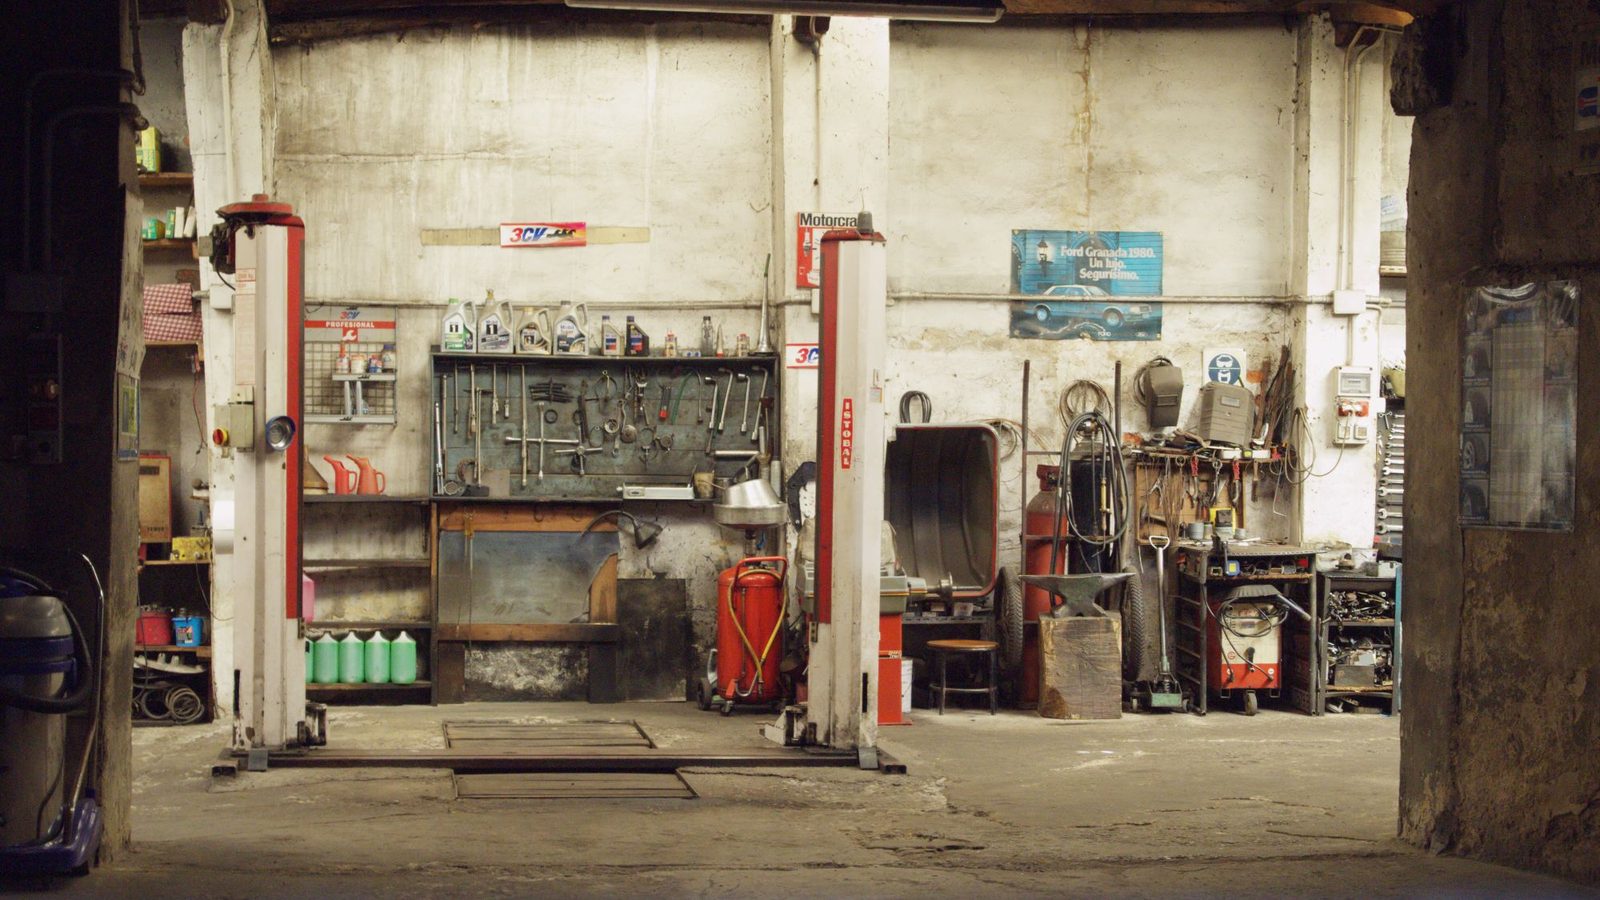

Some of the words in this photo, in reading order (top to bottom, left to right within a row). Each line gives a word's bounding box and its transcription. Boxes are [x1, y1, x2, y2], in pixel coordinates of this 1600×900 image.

[800, 212, 857, 227] Motorcra
[510, 227, 548, 242] 3CV
[1060, 246, 1083, 257] Ford
[1085, 247, 1127, 257] Granada
[1128, 247, 1156, 258] 1980.
[1089, 258, 1103, 268] Un
[1105, 258, 1127, 270] lujo.
[1079, 268, 1139, 281] Segurísimo.
[340, 311, 360, 320] 3CV
[325, 320, 375, 328] PROFESIONAL
[795, 348, 819, 364] 3C
[842, 401, 852, 465] ISTOBAL
